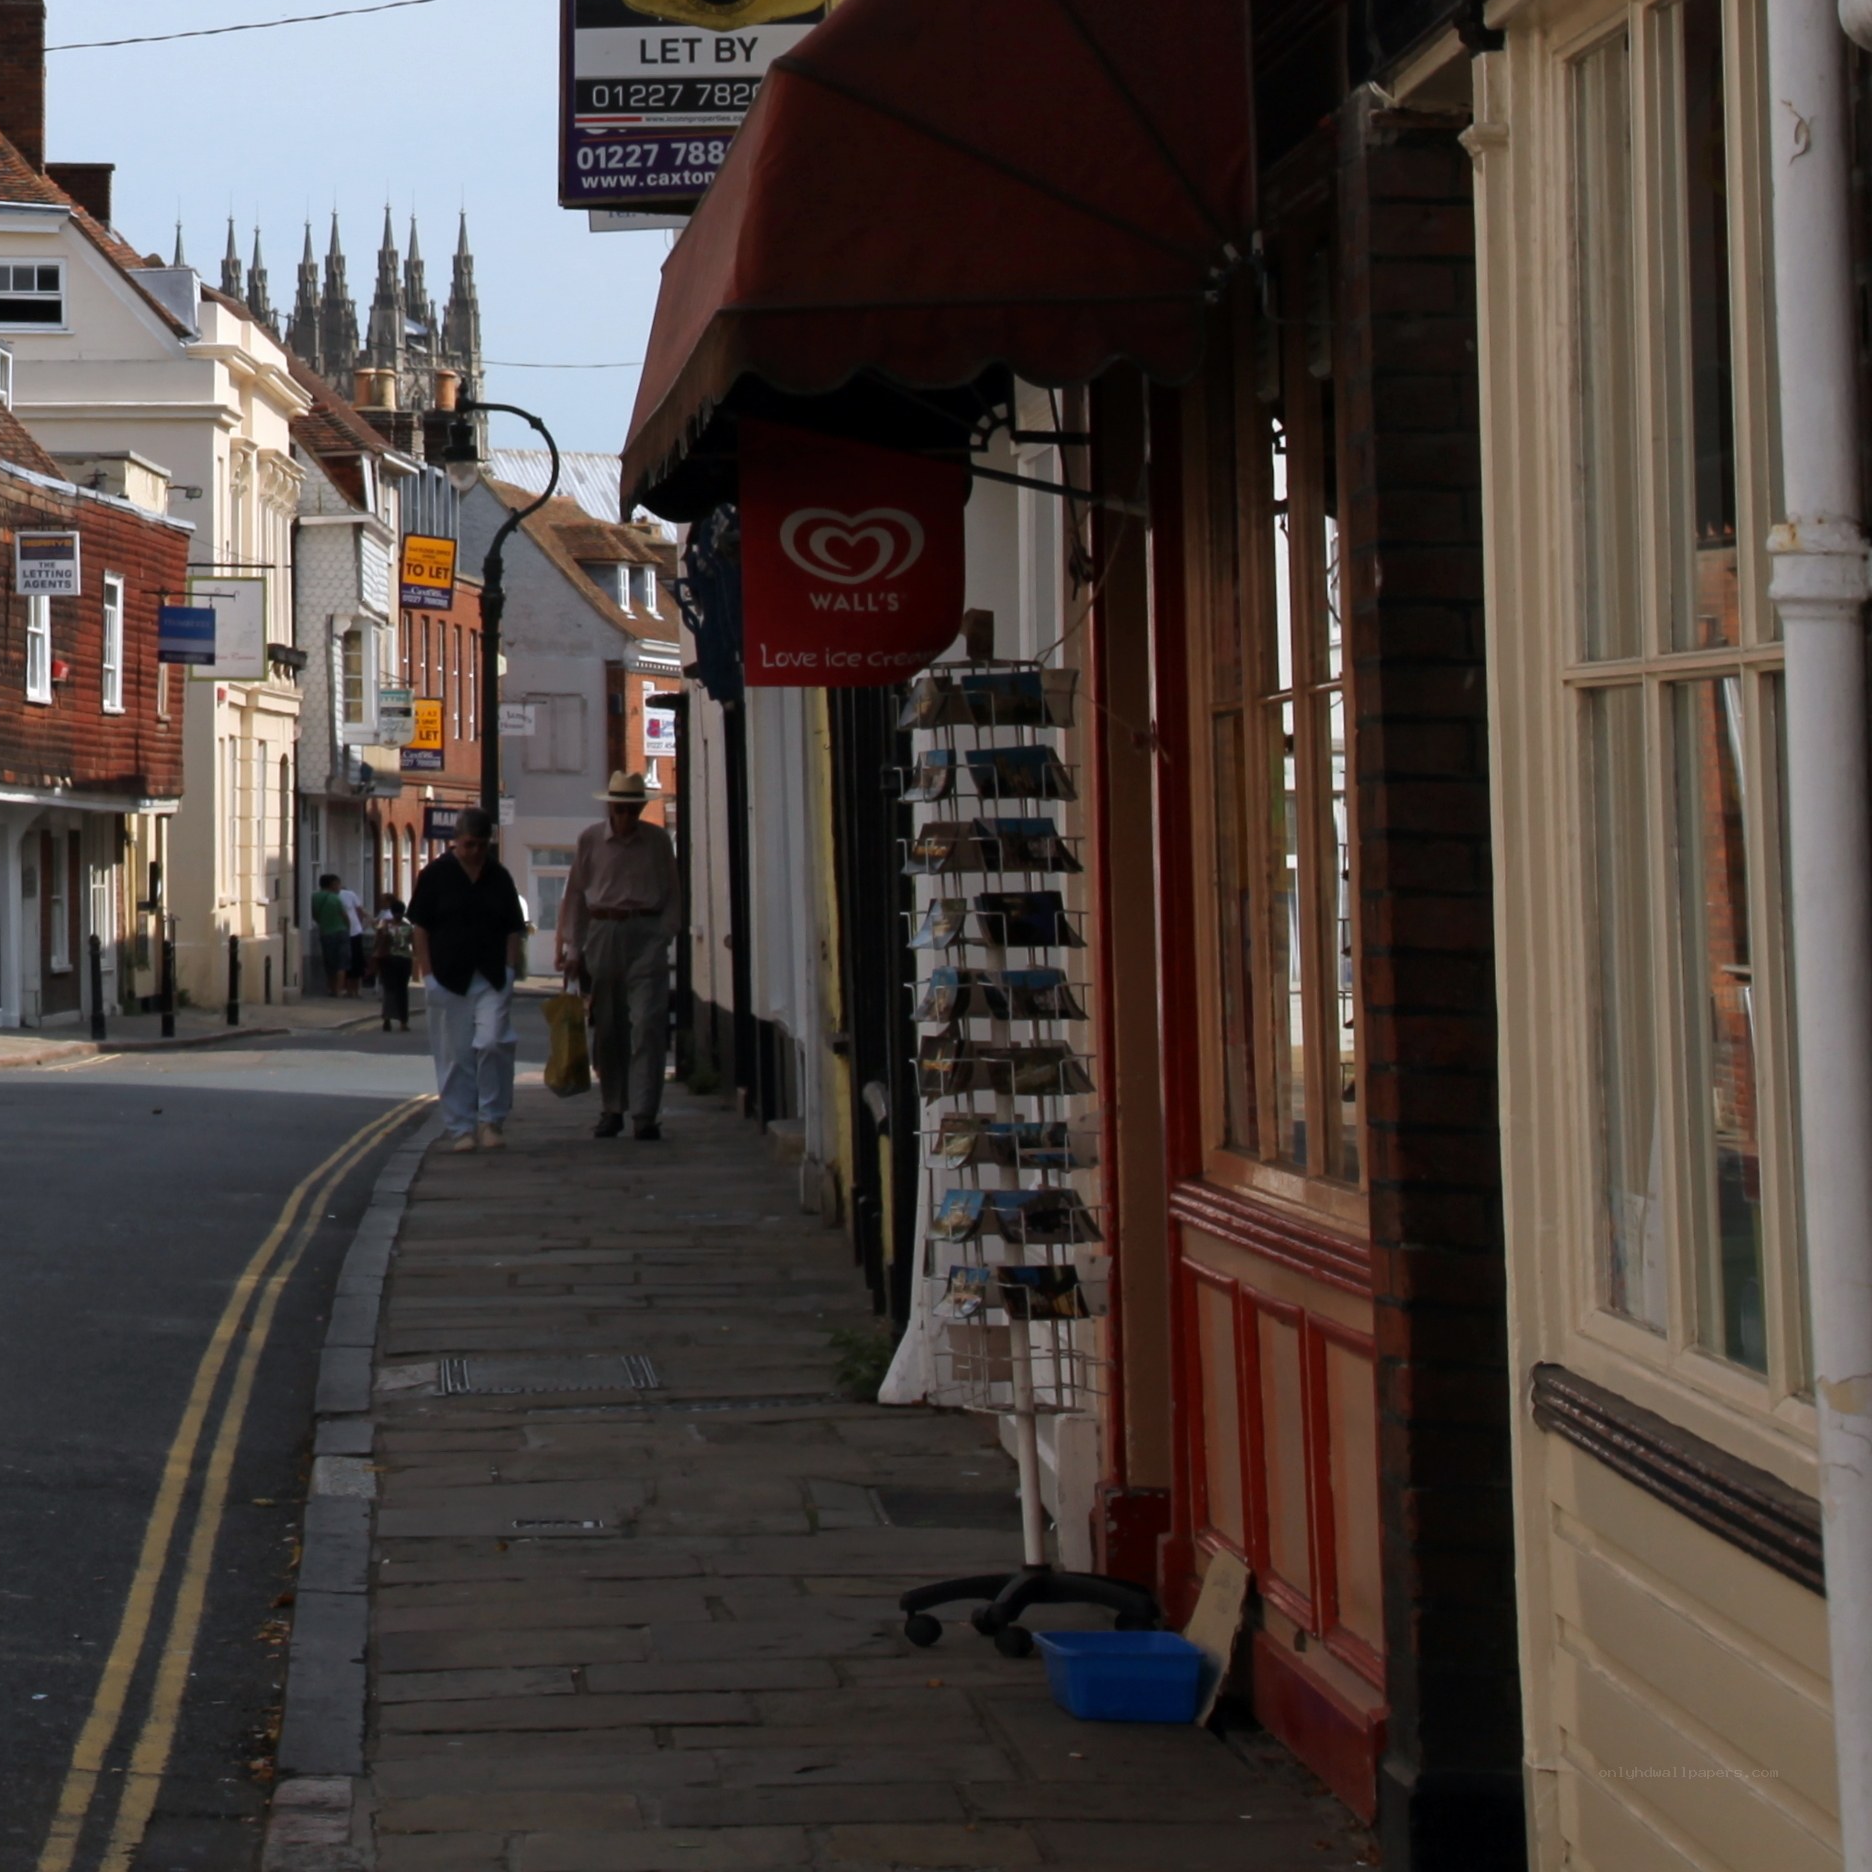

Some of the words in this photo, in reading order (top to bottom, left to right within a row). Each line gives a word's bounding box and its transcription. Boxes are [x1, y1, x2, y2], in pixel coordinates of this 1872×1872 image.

[640, 38, 702, 64] LET
[716, 37, 759, 64] BY
[593, 85, 683, 107] 01227
[577, 143, 660, 170] 01227
[671, 140, 732, 166] 788
[23, 569, 73, 579] LETTING
[39, 561, 55, 569] THE
[406, 562, 424, 577] TO
[428, 565, 450, 580] LET
[23, 579, 72, 589] AGENTS
[808, 592, 901, 613] WALL'S
[760, 643, 817, 669] Love
[825, 646, 863, 668] ice
[419, 730, 440, 741] LET
